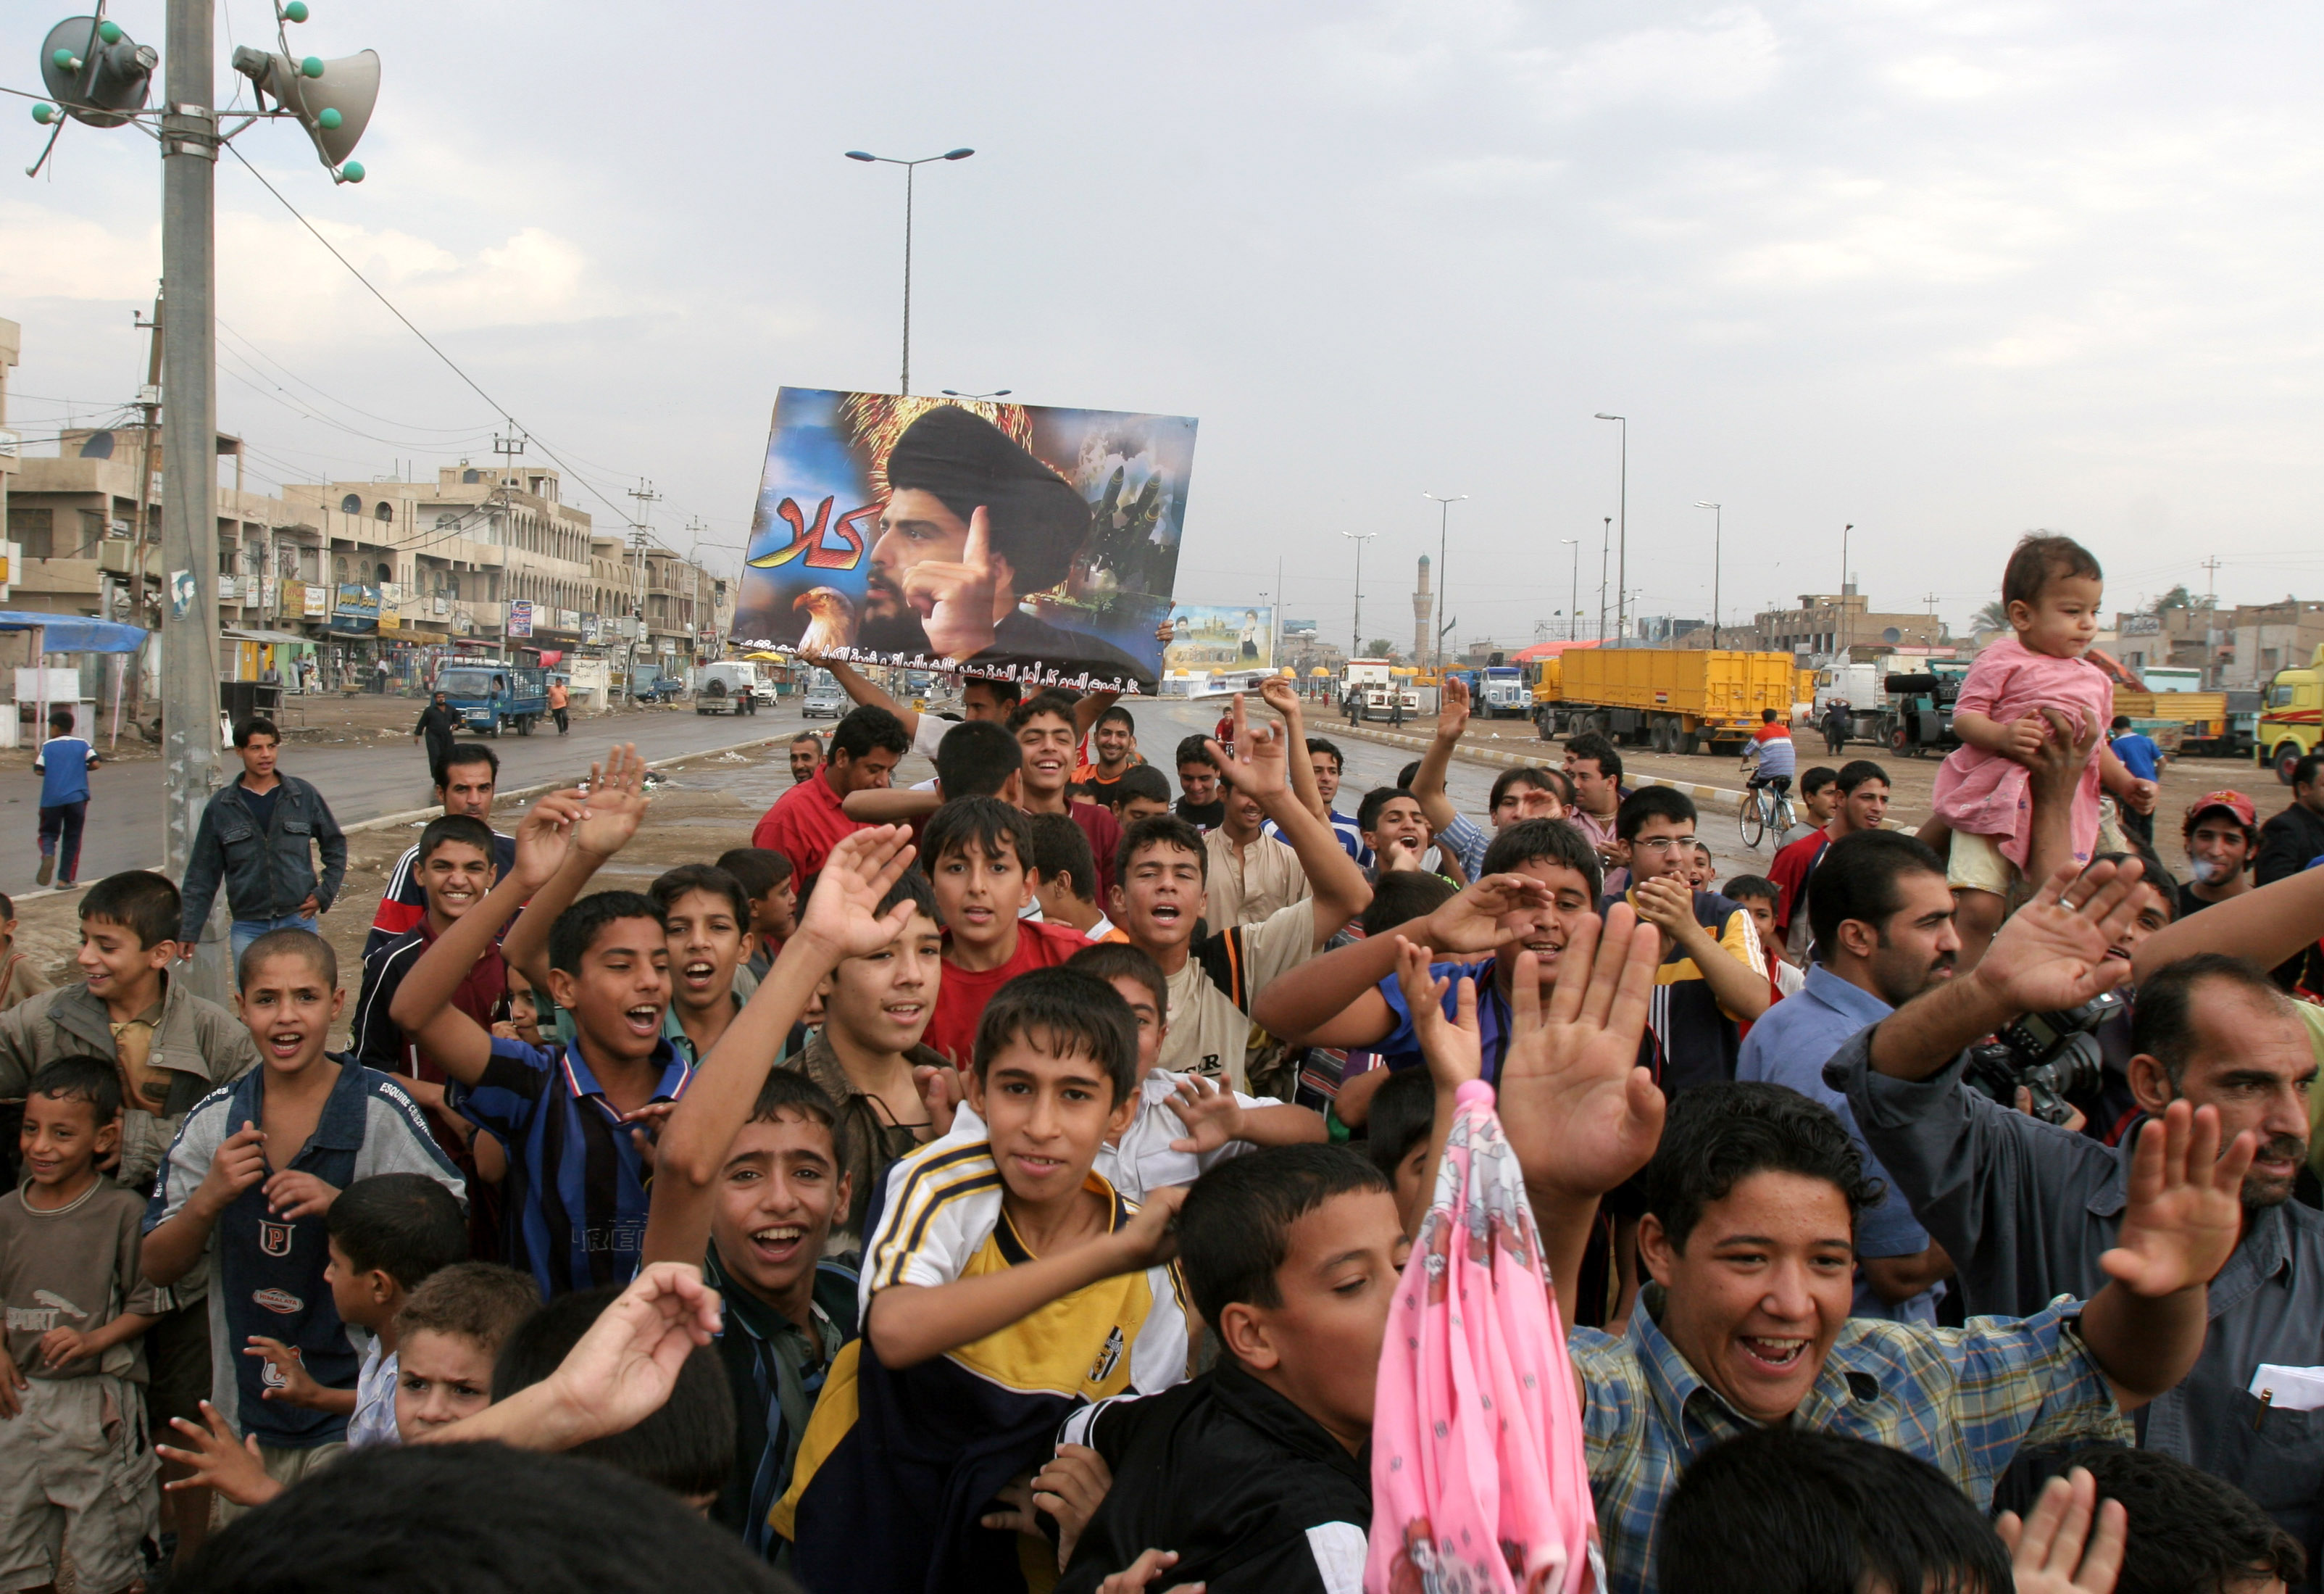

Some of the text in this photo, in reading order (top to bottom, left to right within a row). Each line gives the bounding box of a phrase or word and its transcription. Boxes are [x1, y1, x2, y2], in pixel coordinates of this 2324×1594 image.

[746, 495, 885, 570] كلا
[379, 1082, 412, 1108] ESQUIRE
[268, 1227, 285, 1250] P
[259, 1292, 298, 1306] HIMALAYA
[6, 1306, 59, 1331] SPORT
